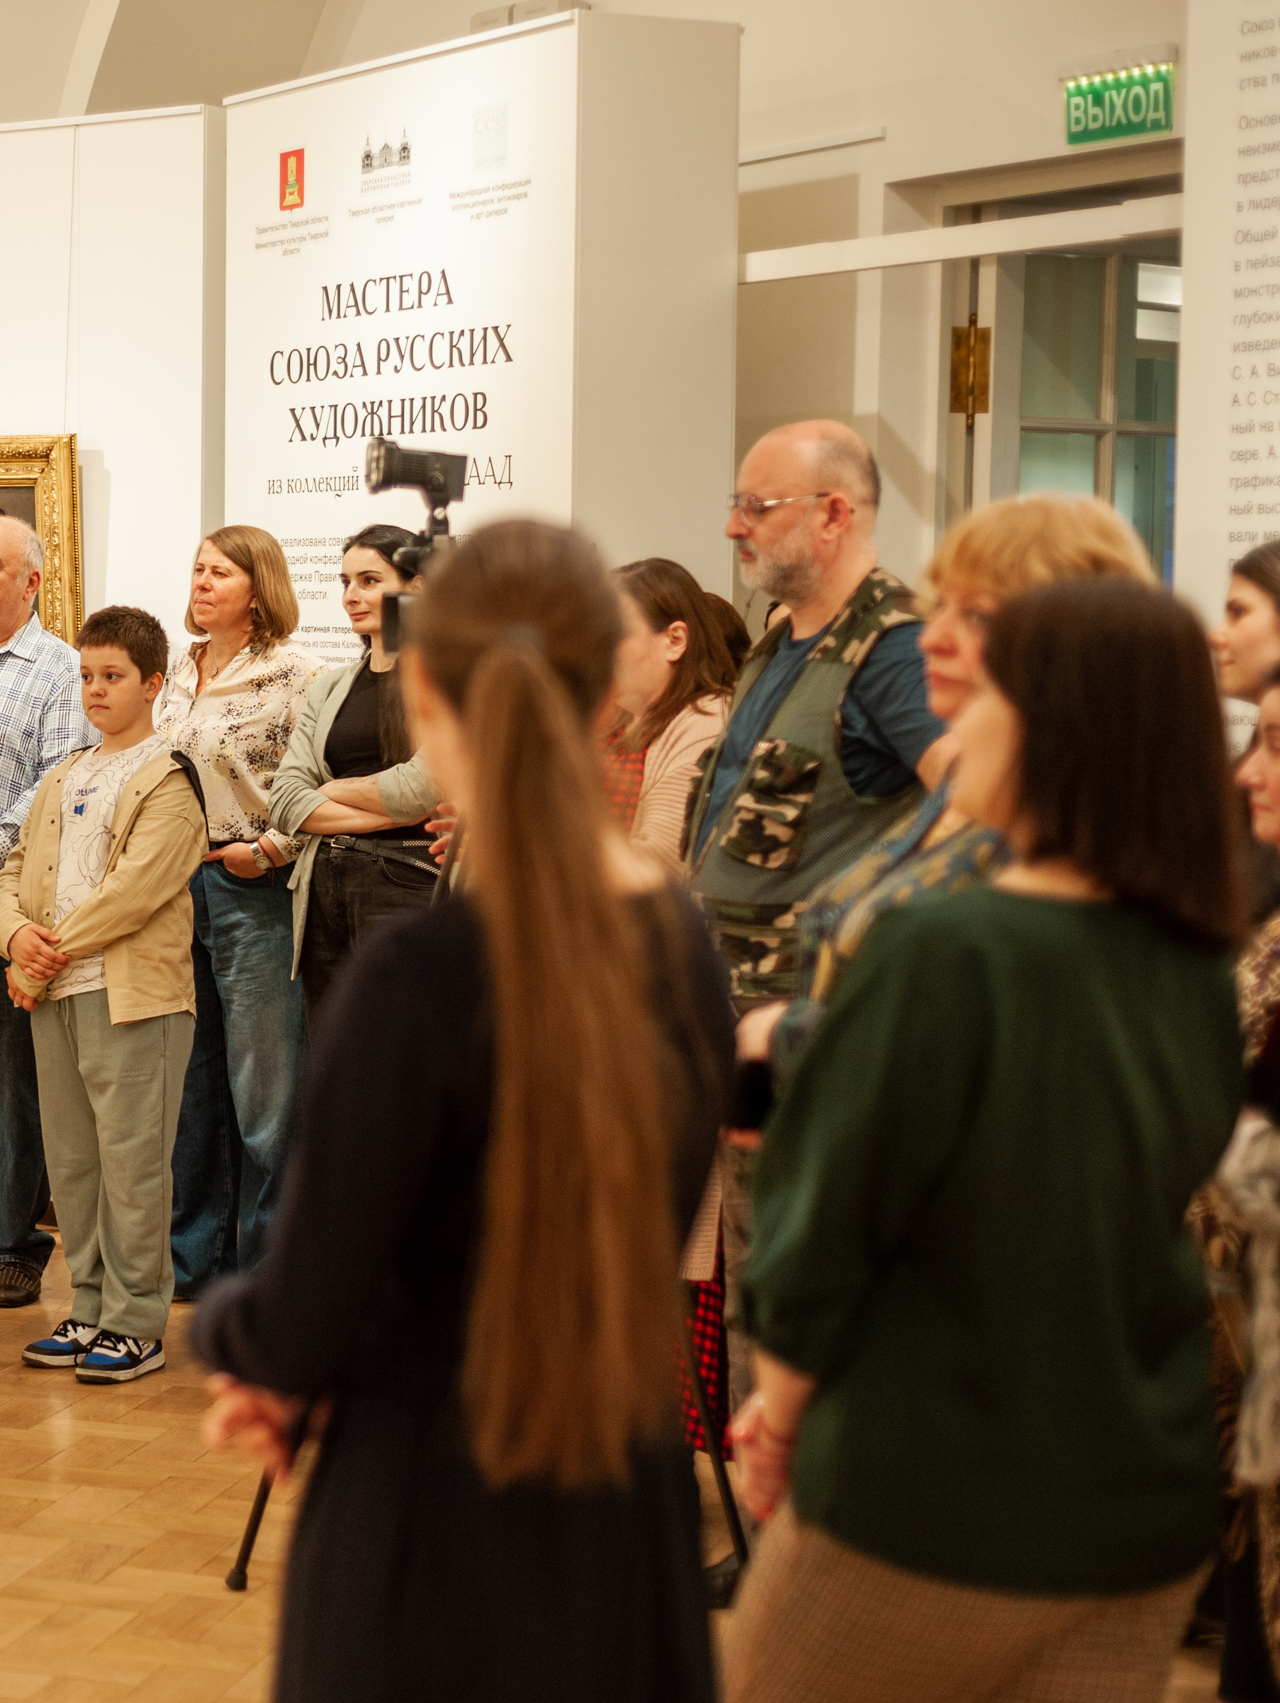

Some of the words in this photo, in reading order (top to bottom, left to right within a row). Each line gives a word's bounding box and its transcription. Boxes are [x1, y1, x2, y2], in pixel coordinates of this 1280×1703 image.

[1240, 18, 1275, 35] Союз
[1240, 46, 1280, 63] ников
[1239, 75, 1267, 91] ства
[1070, 82, 1166, 132] ВЫХОД
[448, 186, 491, 199] Международная
[492, 178, 532, 192] конфедерация
[497, 191, 528, 204] антикваров
[348, 208, 371, 218] Тверская
[371, 203, 396, 214] областная
[396, 198, 423, 210] картинная
[1236, 201, 1244, 212] в
[255, 223, 288, 236] Правительство
[289, 217, 310, 229] Тверской
[310, 215, 329, 225] области
[374, 215, 395, 224] галерея
[255, 239, 286, 250] Министерство
[286, 236, 307, 246] культуры
[308, 229, 329, 241] Тверской
[1235, 226, 1278, 245] Общей
[281, 247, 301, 257] области
[1234, 261, 1242, 272] в
[321, 268, 454, 321] МАСТЕРА
[1234, 284, 1280, 299] монстр
[1233, 338, 1280, 353] изведе
[270, 341, 369, 386] СОЮЗА
[375, 324, 514, 375] РУССКИХ
[1263, 390, 1280, 405] Ст
[288, 391, 488, 448] ХУДОЖНИКОВ
[1231, 419, 1256, 434] ный
[1260, 421, 1274, 432] на
[1231, 449, 1262, 464] сере,
[267, 479, 283, 495] из
[286, 465, 360, 499] коллекций
[464, 455, 513, 490] ААД
[1229, 501, 1254, 515] ный
[280, 537, 327, 548] реализована
[1229, 531, 1259, 543] вали
[285, 553, 308, 566] одной
[290, 573, 313, 585] ержке
[314, 570, 341, 585] Правит
[297, 588, 329, 601] области.
[300, 626, 331, 635] картинная
